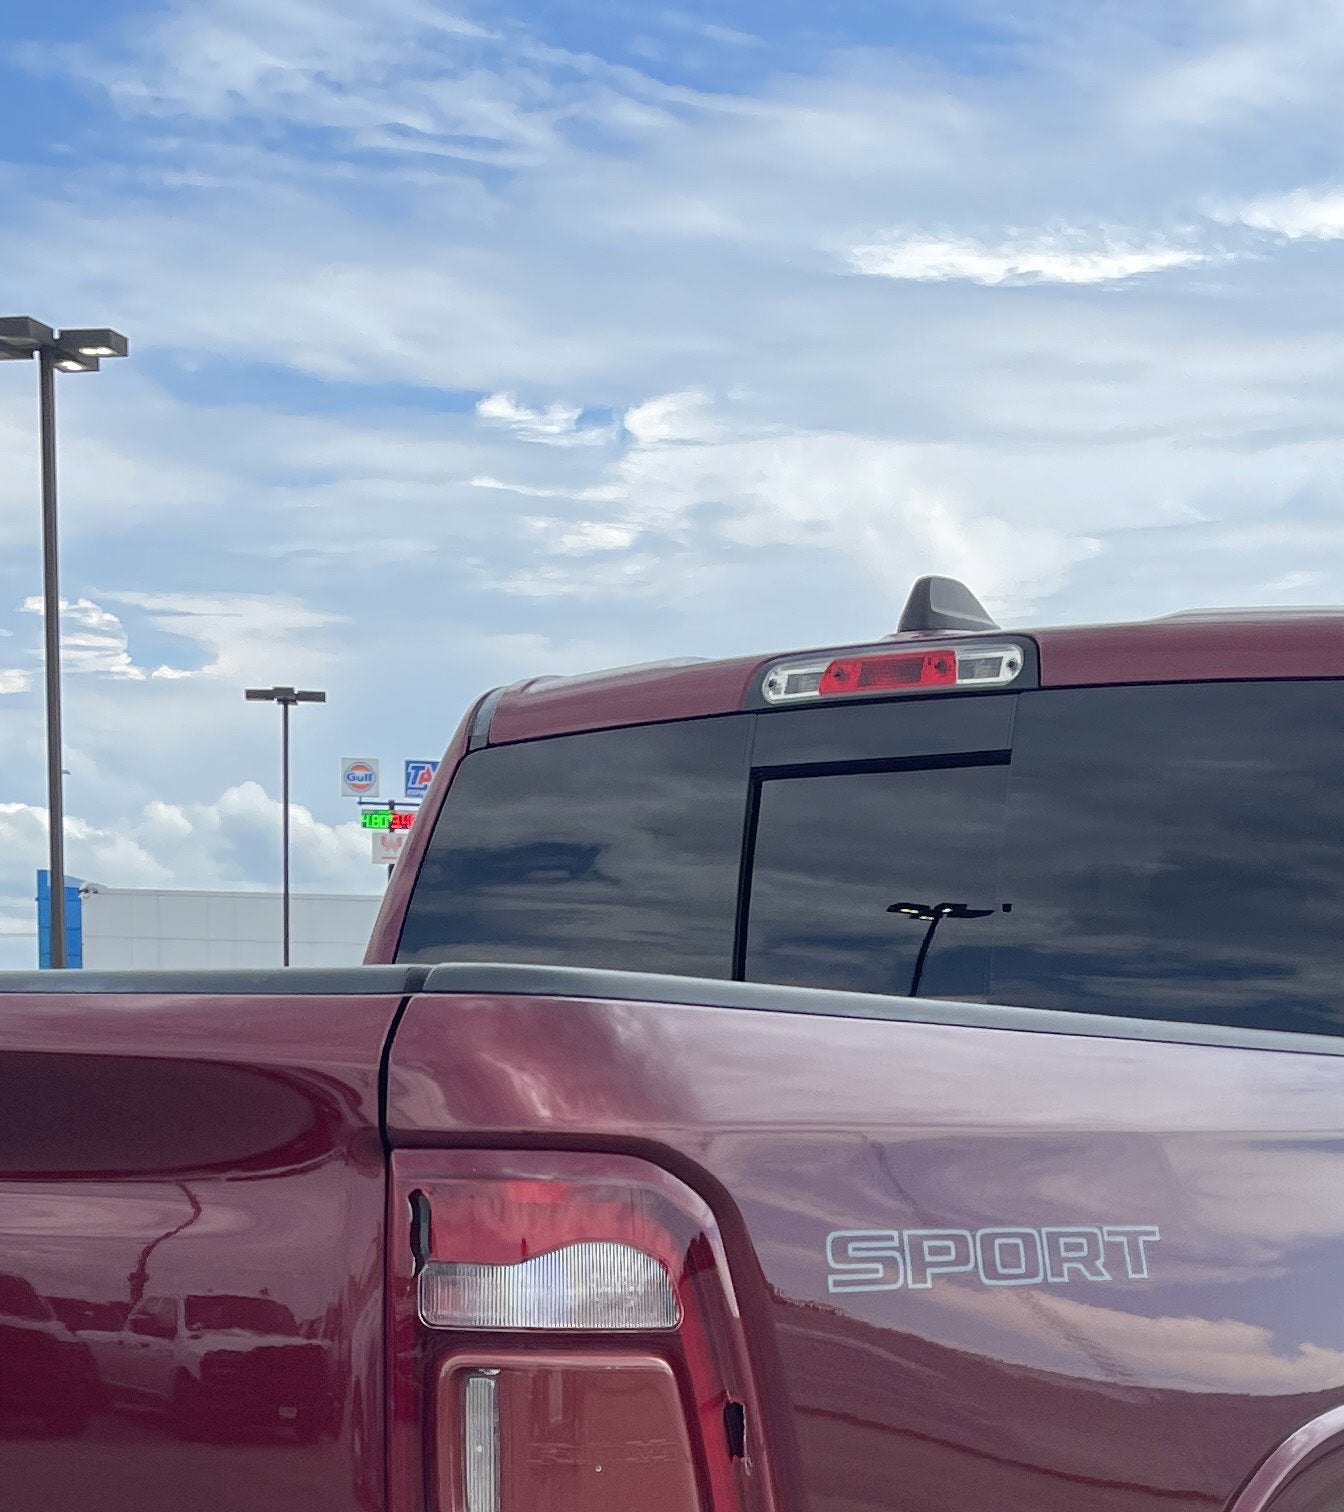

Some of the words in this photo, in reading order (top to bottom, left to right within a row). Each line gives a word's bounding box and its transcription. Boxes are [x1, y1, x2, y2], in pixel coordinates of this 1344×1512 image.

[347, 773, 374, 782] Gulf
[407, 763, 433, 788] TA
[826, 1226, 1160, 1294] SPORT
